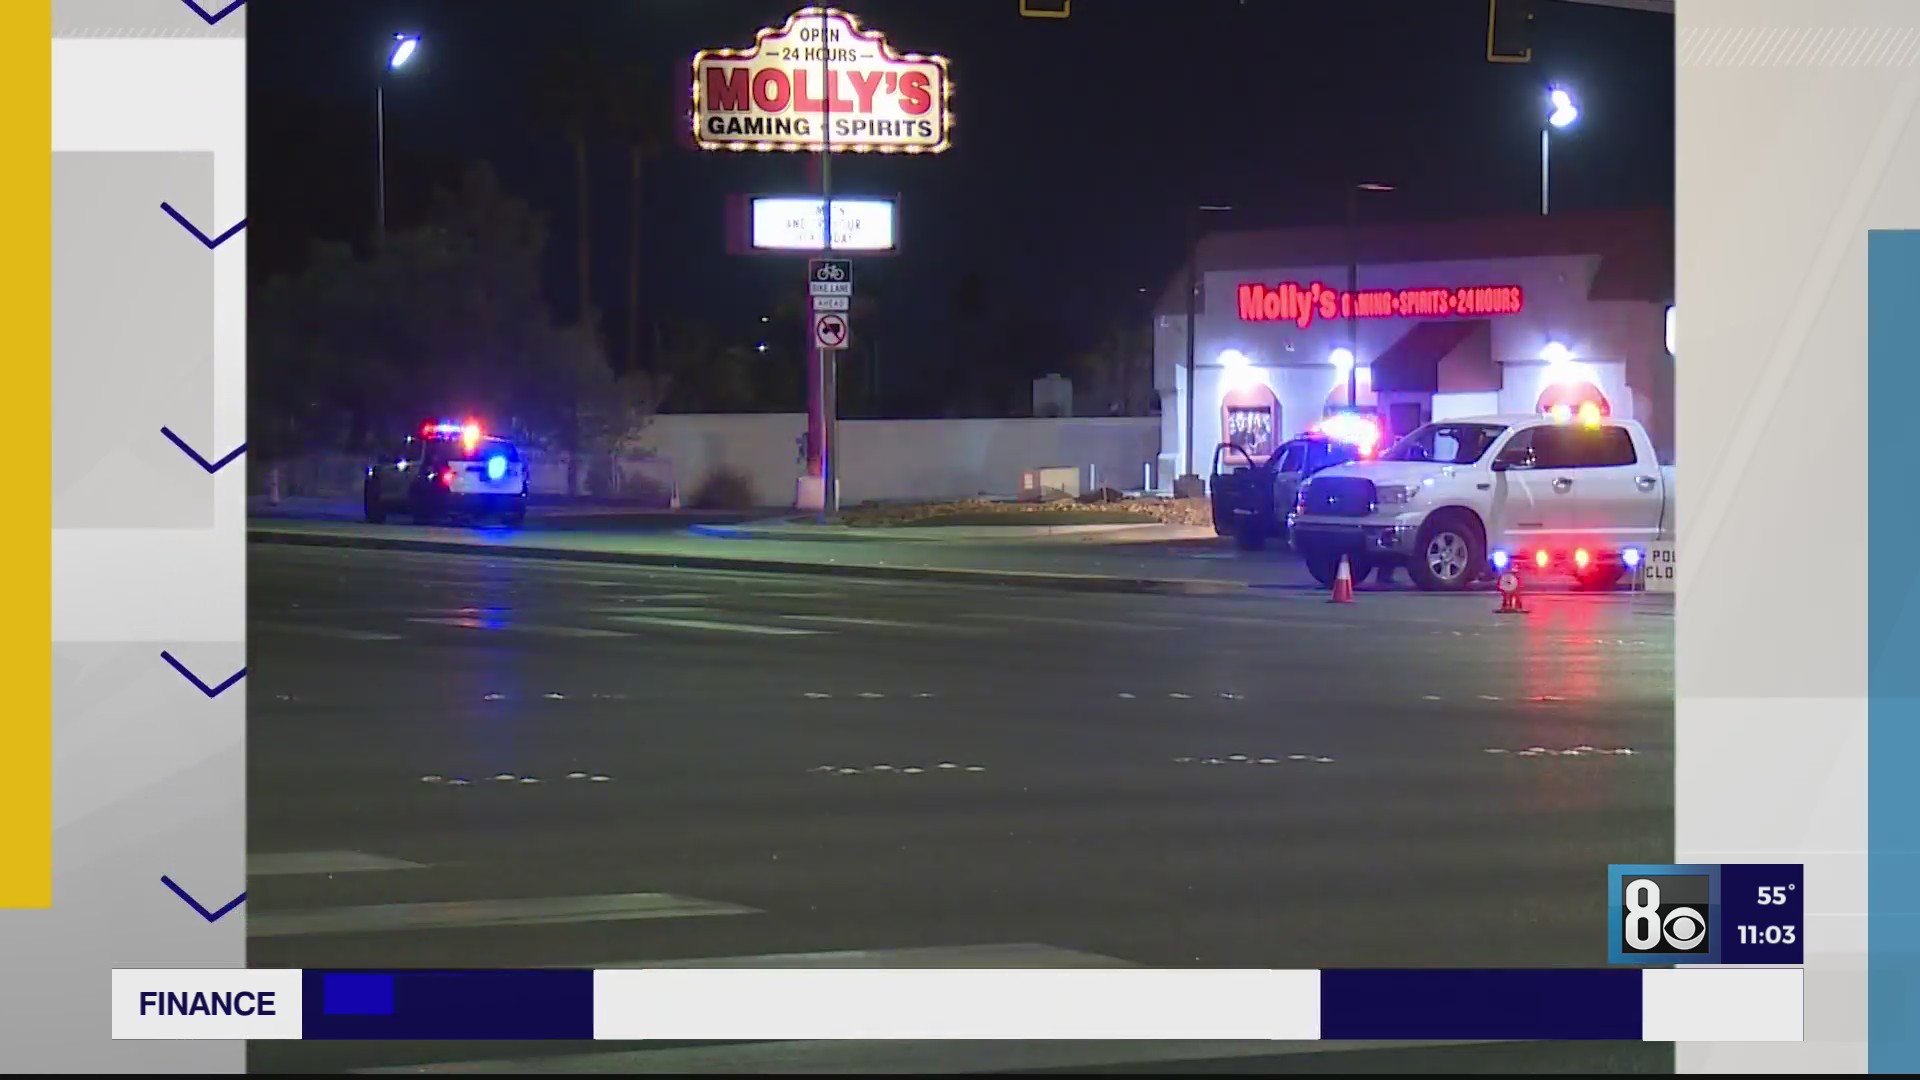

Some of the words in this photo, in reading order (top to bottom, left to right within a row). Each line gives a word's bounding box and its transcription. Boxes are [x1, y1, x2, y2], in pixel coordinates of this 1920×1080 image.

[782, 47, 799, 61] 24
[805, 48, 857, 62] HOURS
[706, 67, 932, 115] MOLLY'S
[707, 116, 810, 136] GAMING
[836, 118, 932, 137] SPIRITS
[812, 282, 829, 293] BIKE
[830, 282, 849, 293] LANE
[1238, 281, 1338, 329] Molly's
